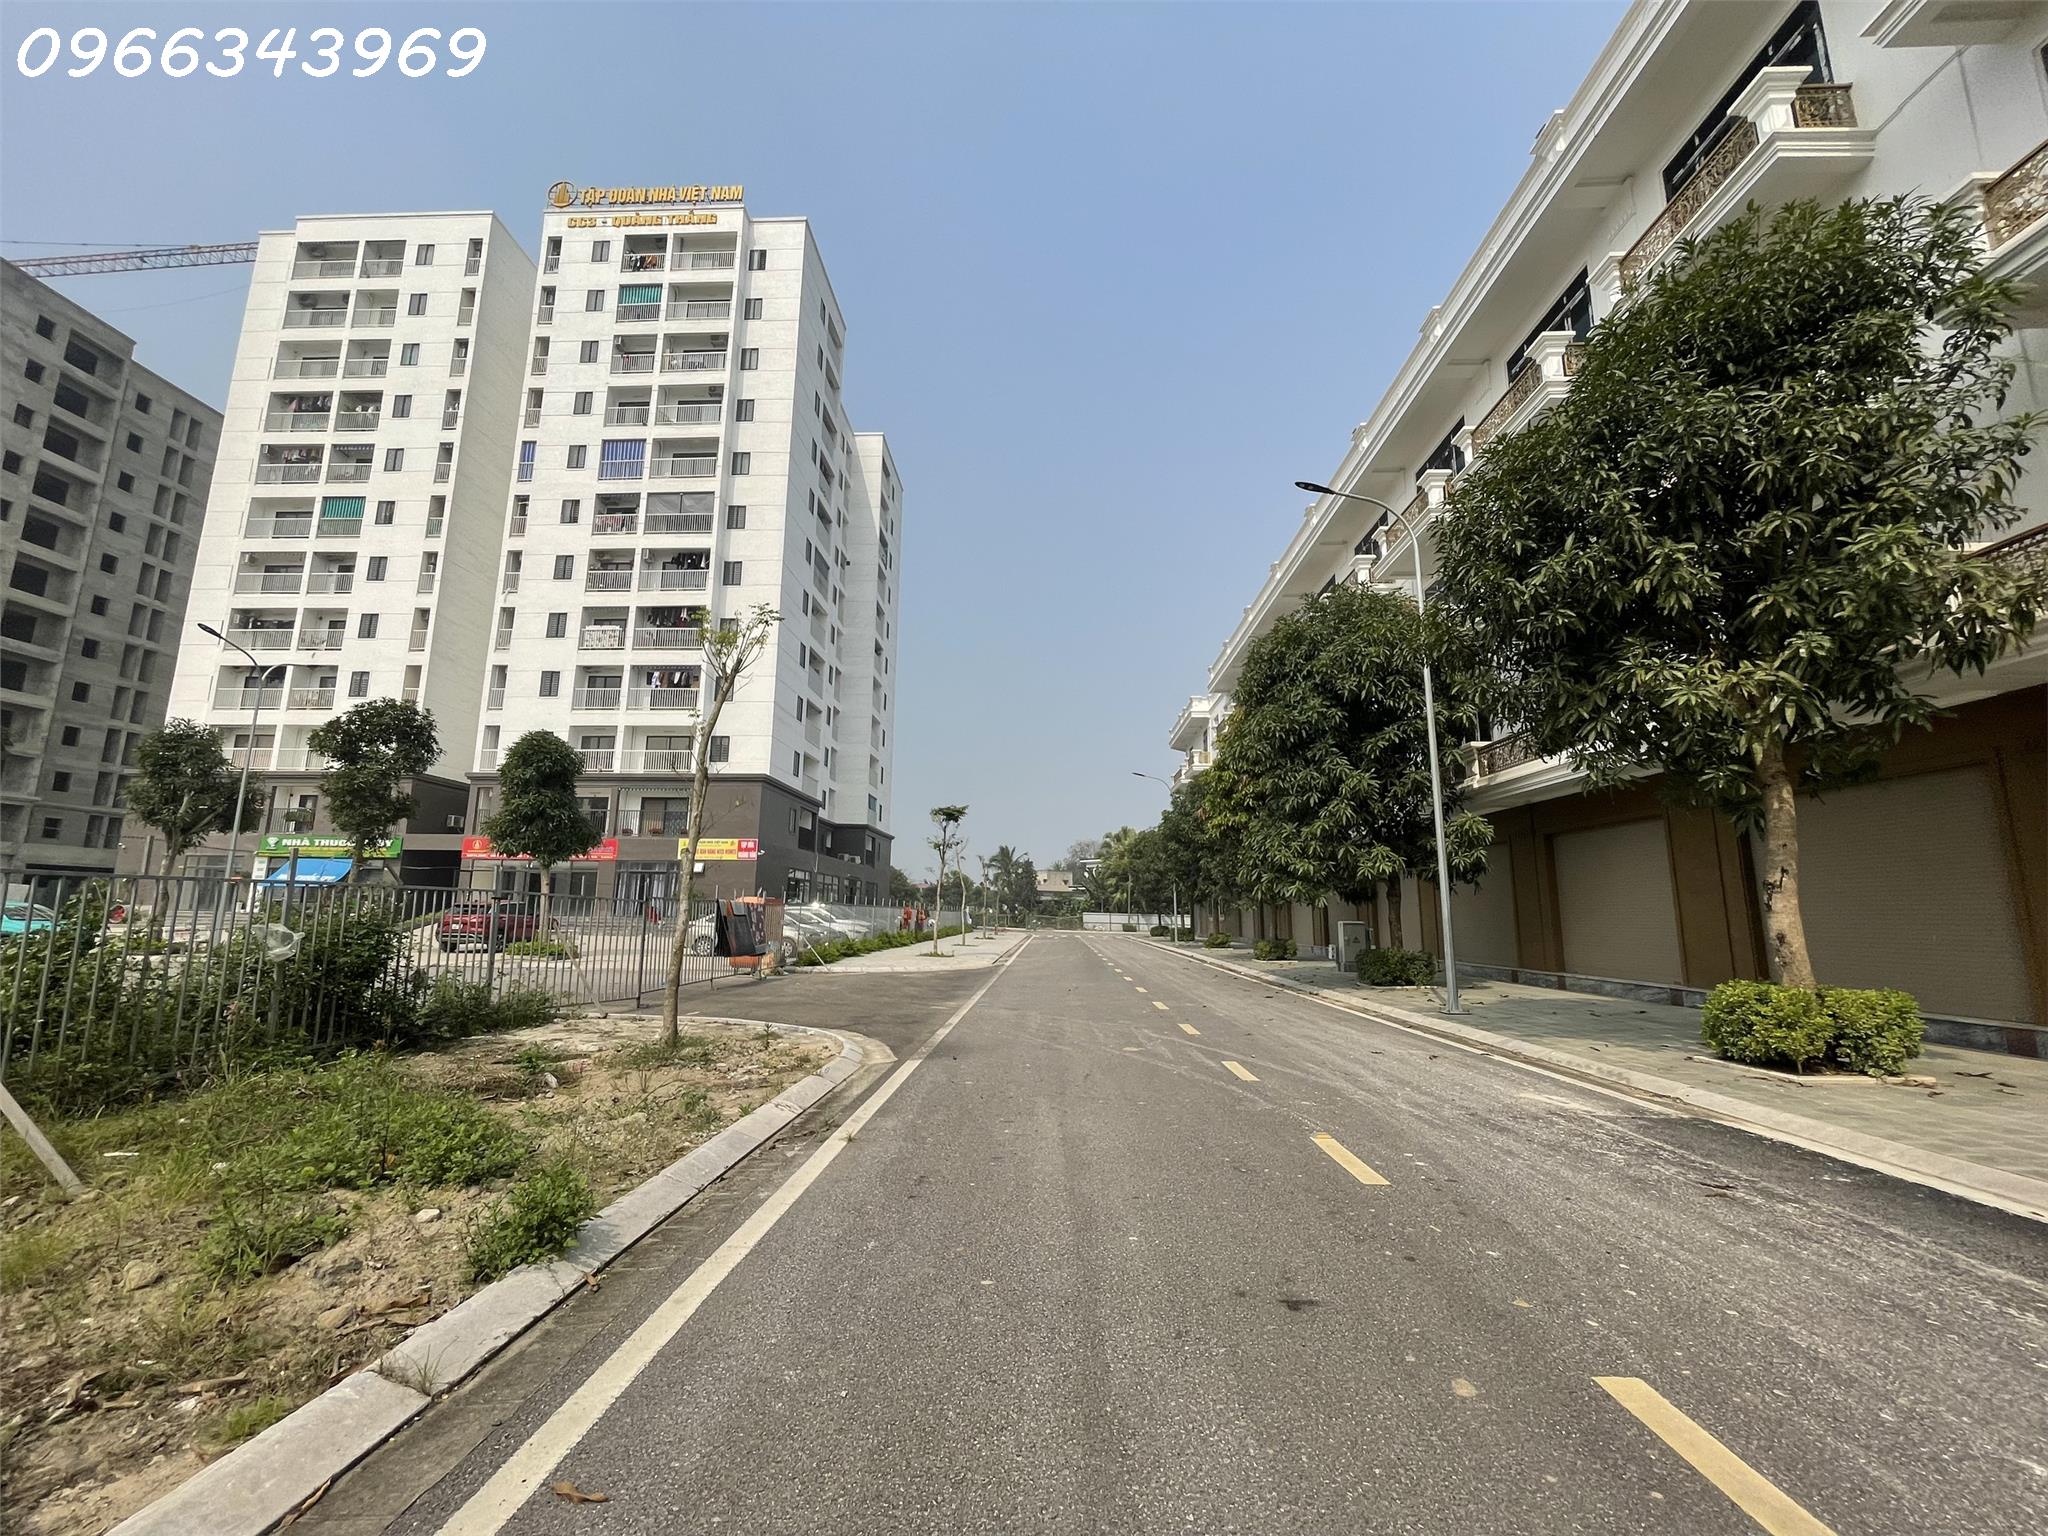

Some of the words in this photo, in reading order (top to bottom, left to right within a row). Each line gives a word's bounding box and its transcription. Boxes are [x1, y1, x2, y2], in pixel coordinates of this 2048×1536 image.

[580, 187, 605, 206] TẬP
[608, 186, 646, 204] ĐOÀN
[679, 185, 708, 205] VIỆT
[710, 185, 744, 202] NAM
[667, 210, 718, 225] THẮNG
[282, 837, 310, 847] NHÀ
